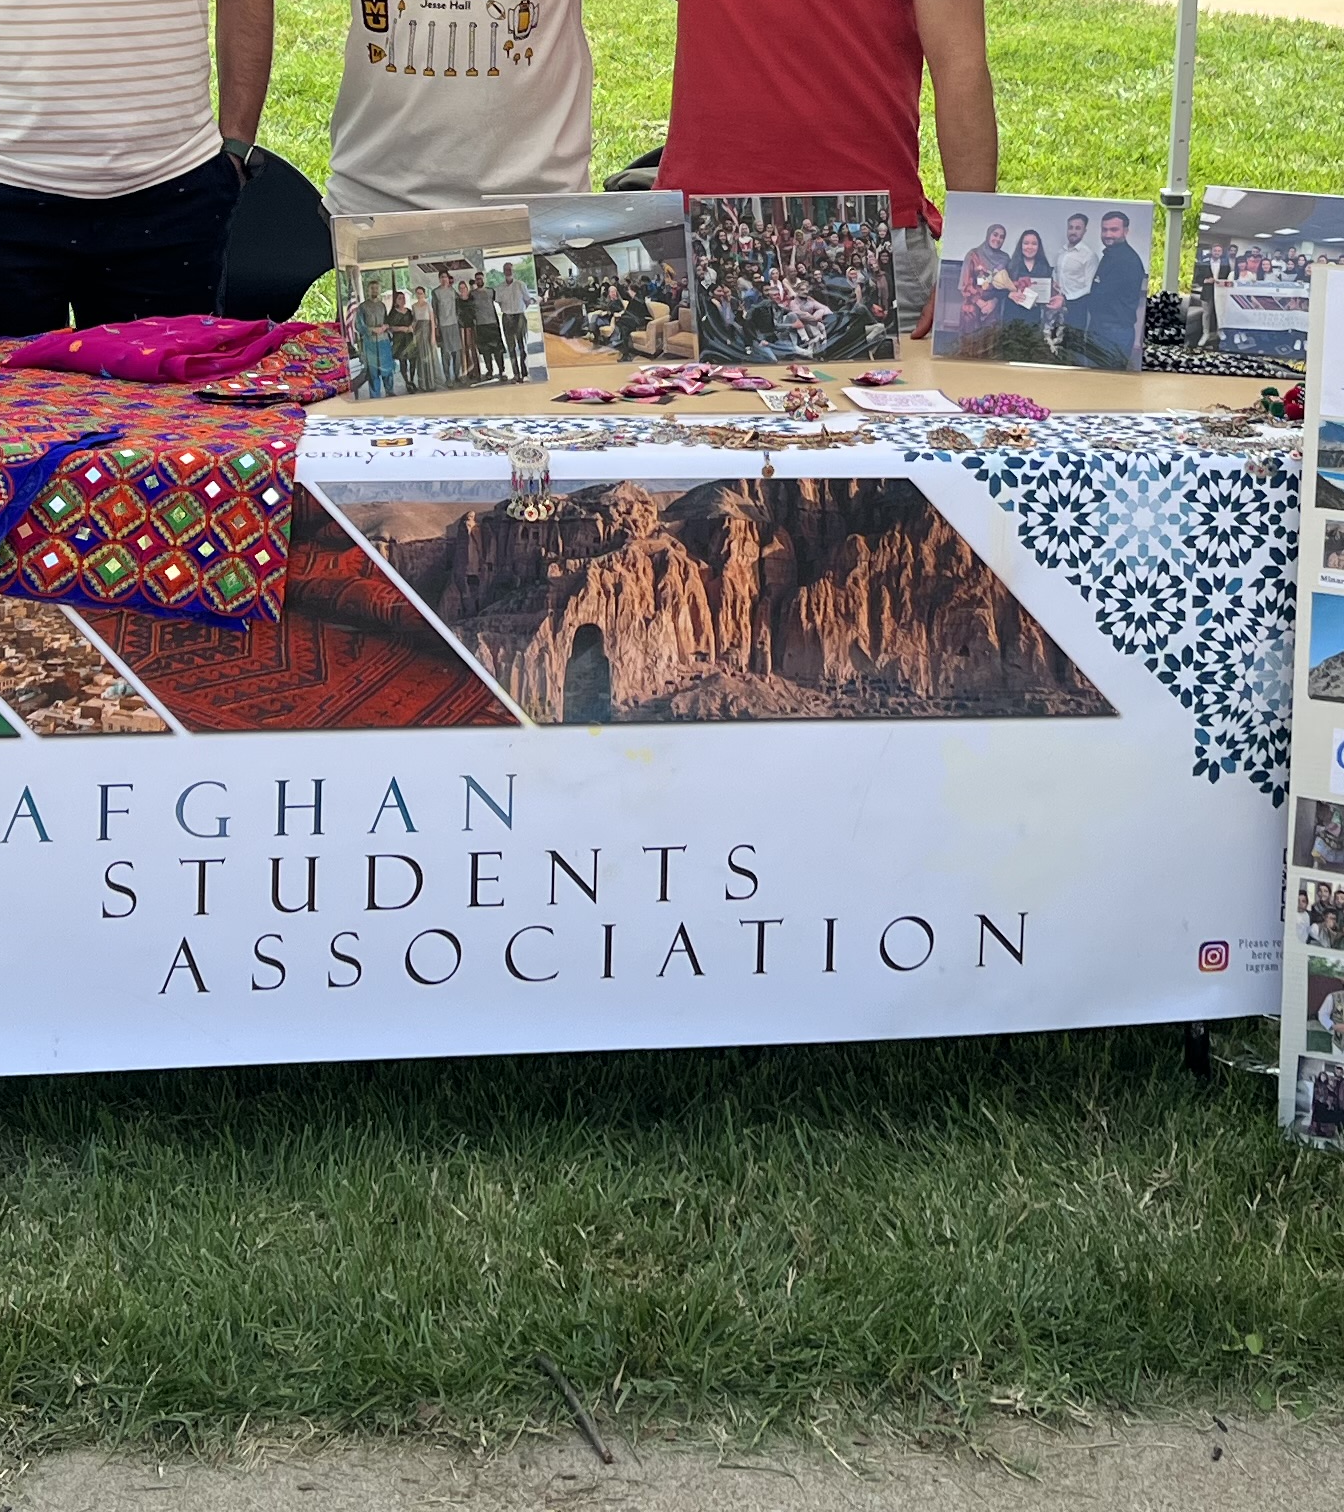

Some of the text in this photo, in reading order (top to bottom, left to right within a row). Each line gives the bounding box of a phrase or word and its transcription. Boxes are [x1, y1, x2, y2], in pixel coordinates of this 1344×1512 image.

[419, 0, 471, 10] Jesse Hall
[389, 448, 415, 459] of
[0, 773, 520, 843] AFGHAN
[101, 843, 761, 919] STUDENTS
[1238, 938, 1269, 950] Please
[158, 911, 1031, 996] ASSOCIATION
[1251, 950, 1272, 960] here
